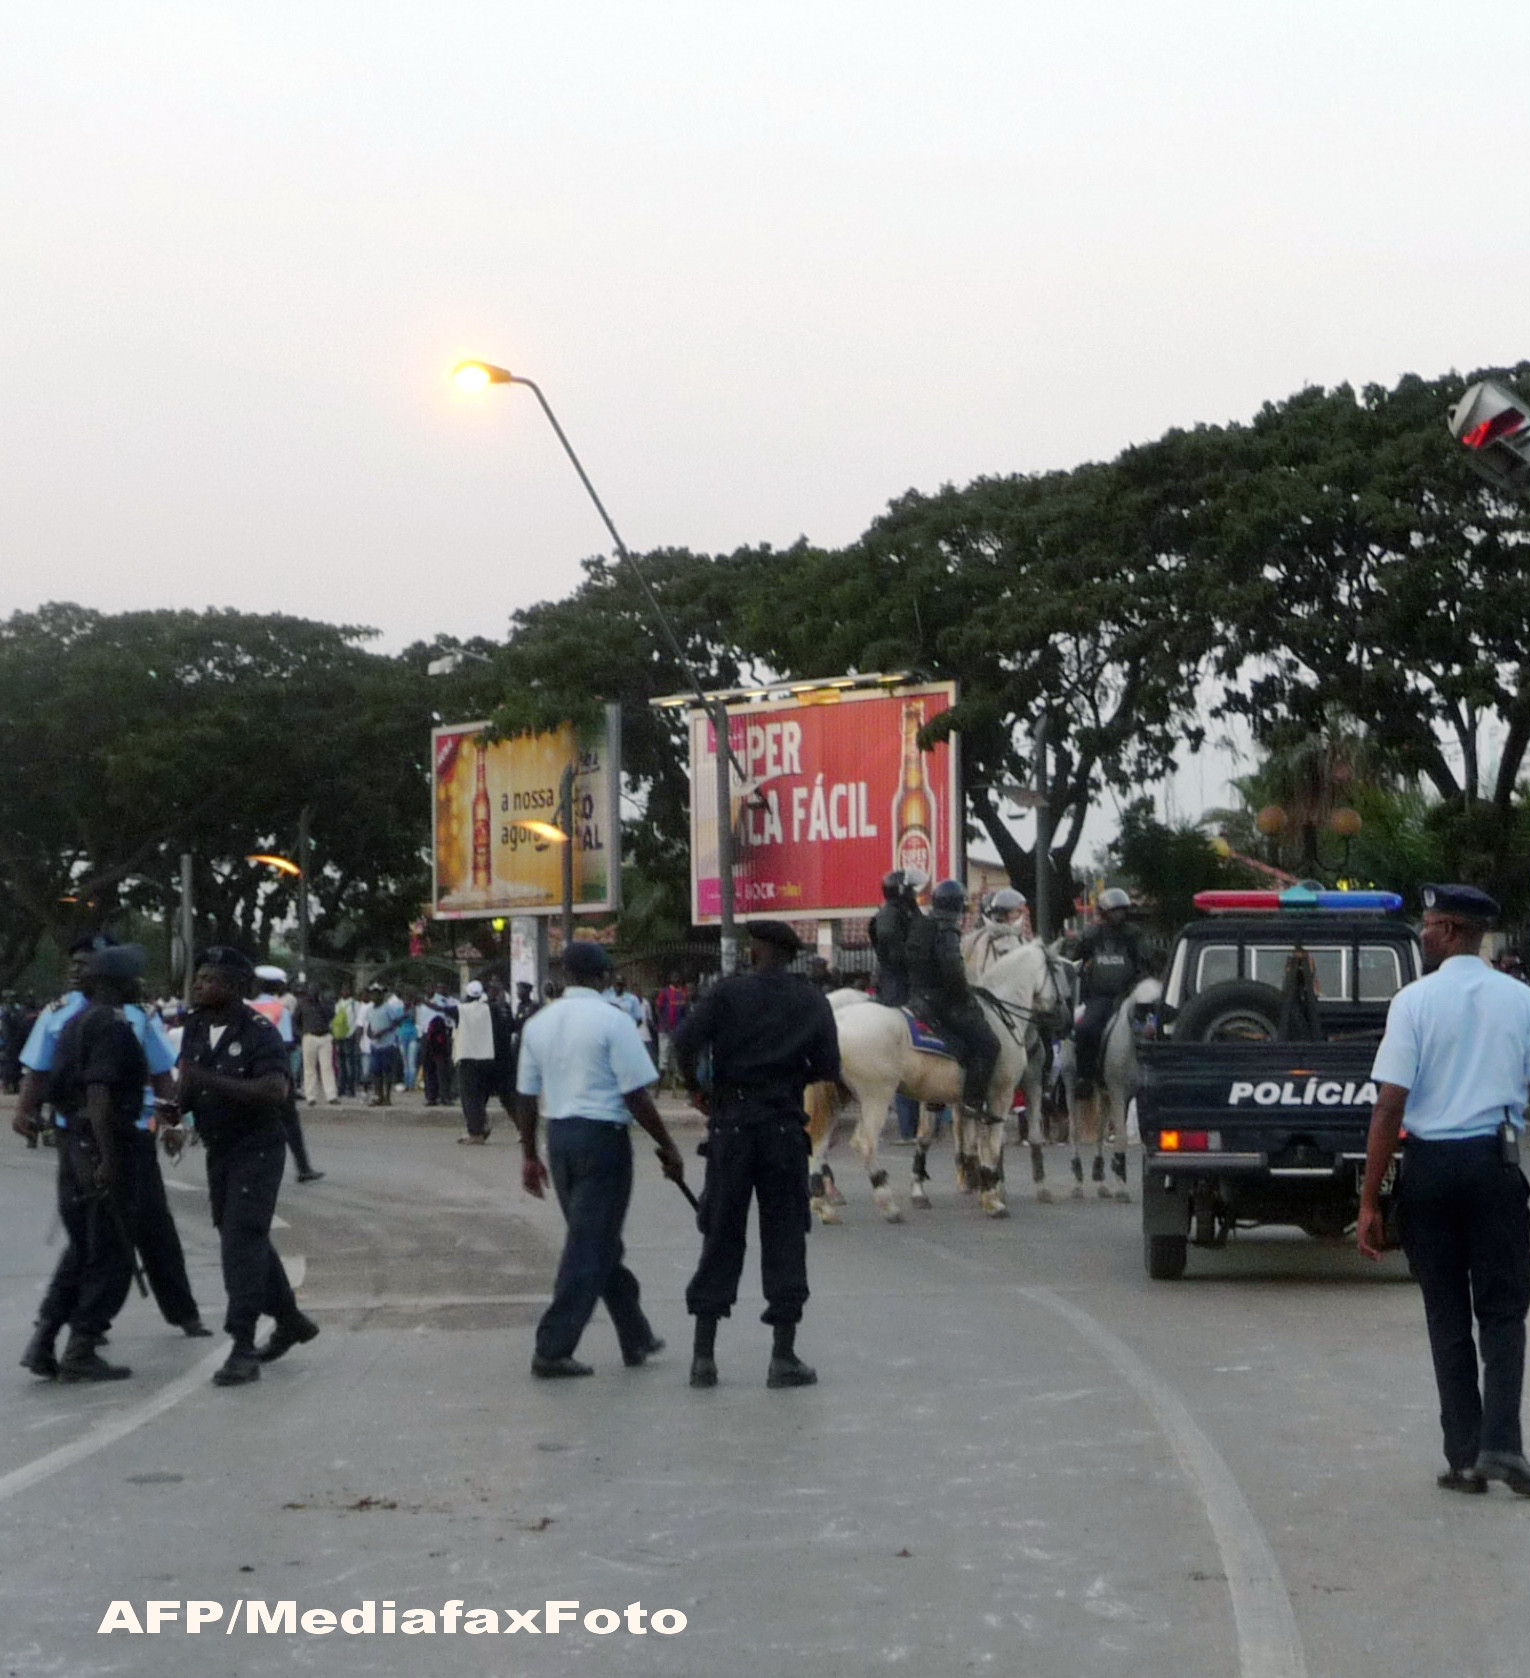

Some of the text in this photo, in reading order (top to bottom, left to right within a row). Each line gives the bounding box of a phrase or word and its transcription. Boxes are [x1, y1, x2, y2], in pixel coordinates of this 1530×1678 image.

[732, 720, 802, 775] PER
[501, 788, 554, 811] a nossa
[793, 772, 877, 843] FÁCIL
[577, 824, 603, 851] AL
[1228, 1077, 1379, 1105] POLÍCIA
